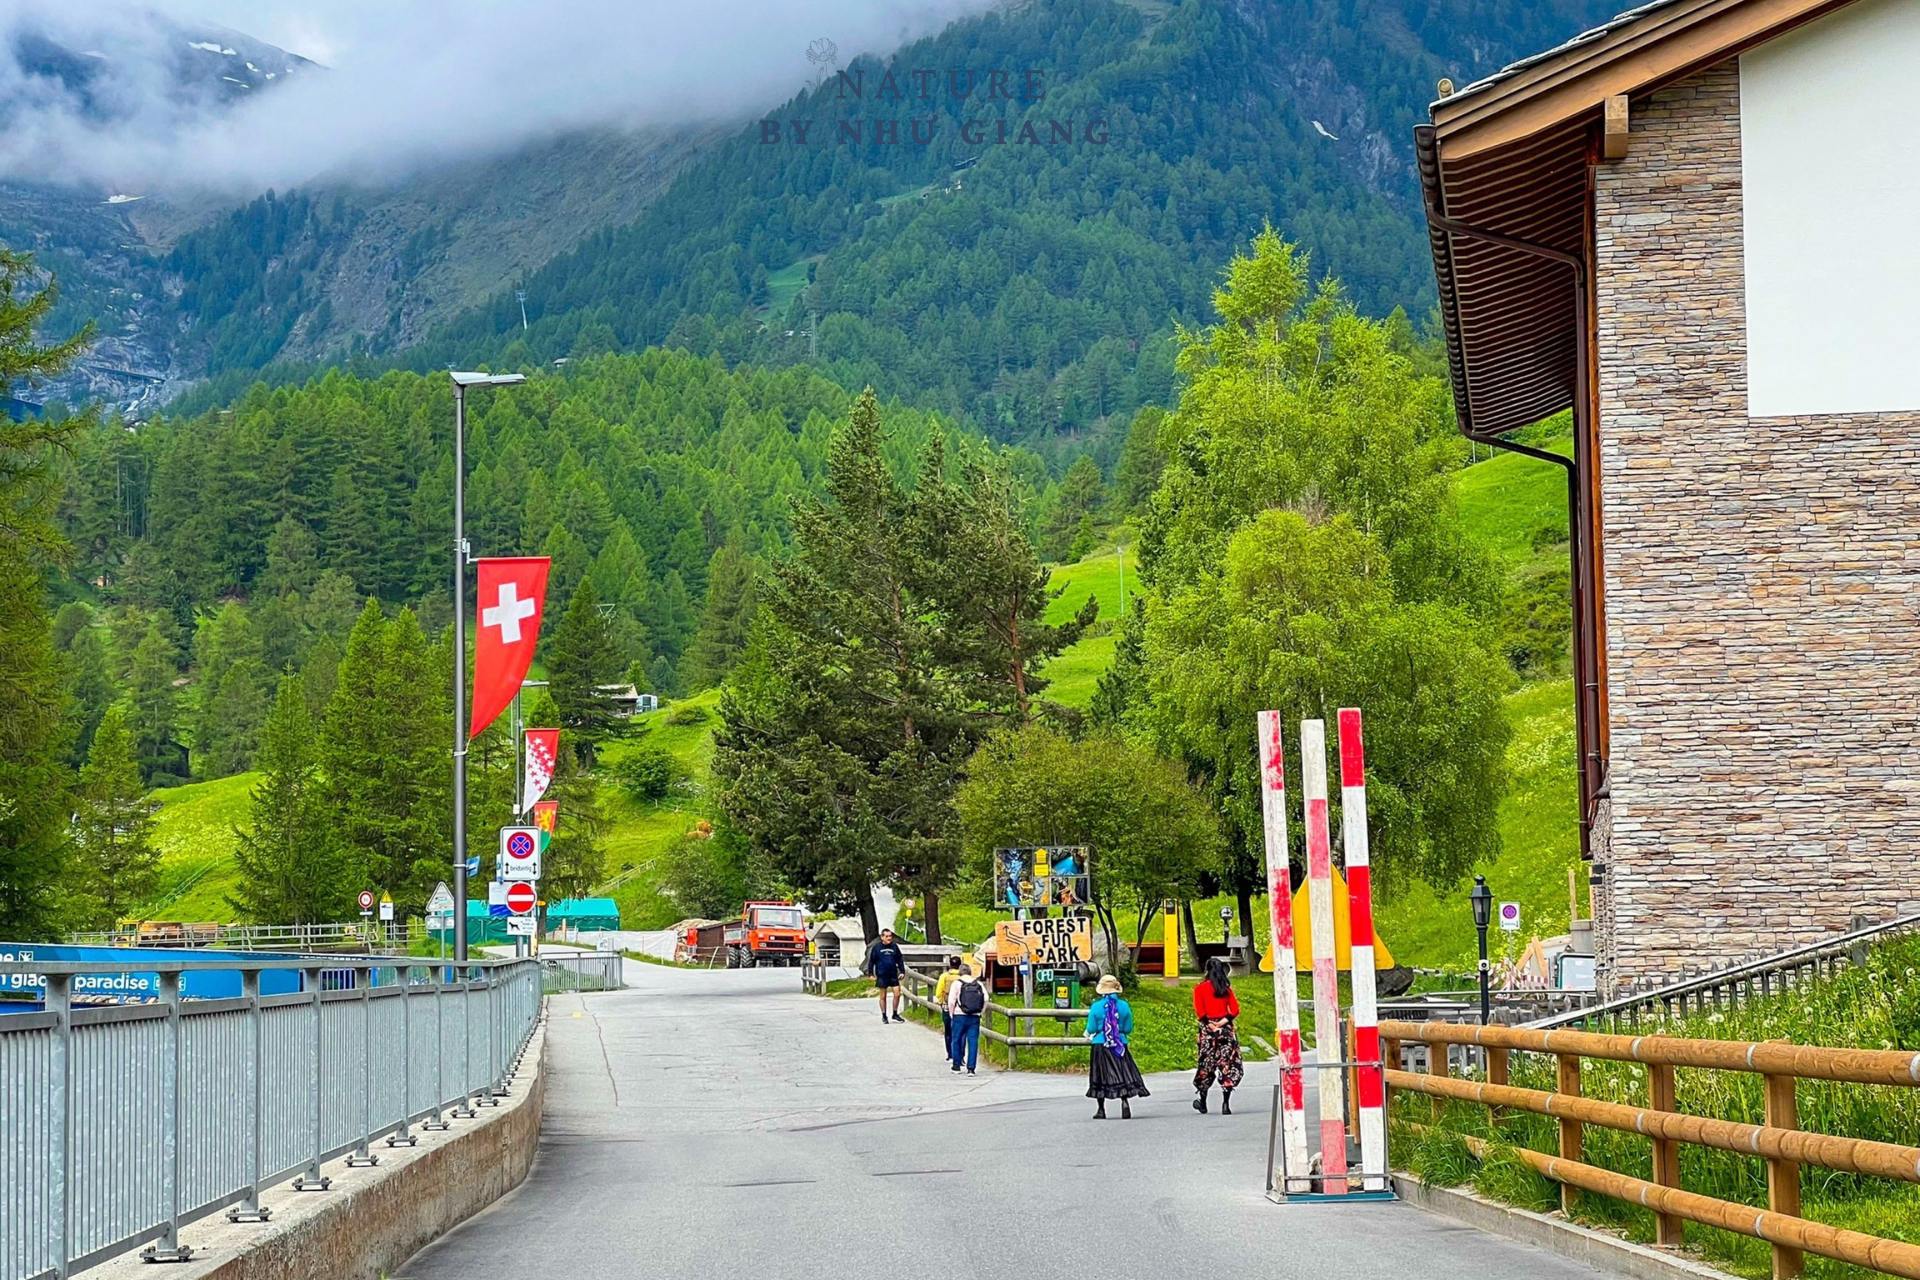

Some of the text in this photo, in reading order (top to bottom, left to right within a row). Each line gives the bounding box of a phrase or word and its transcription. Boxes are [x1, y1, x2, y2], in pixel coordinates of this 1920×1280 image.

[1023, 918, 1086, 935] FOREST
[1036, 946, 1080, 963] PARK
[74, 972, 149, 993] paradise
